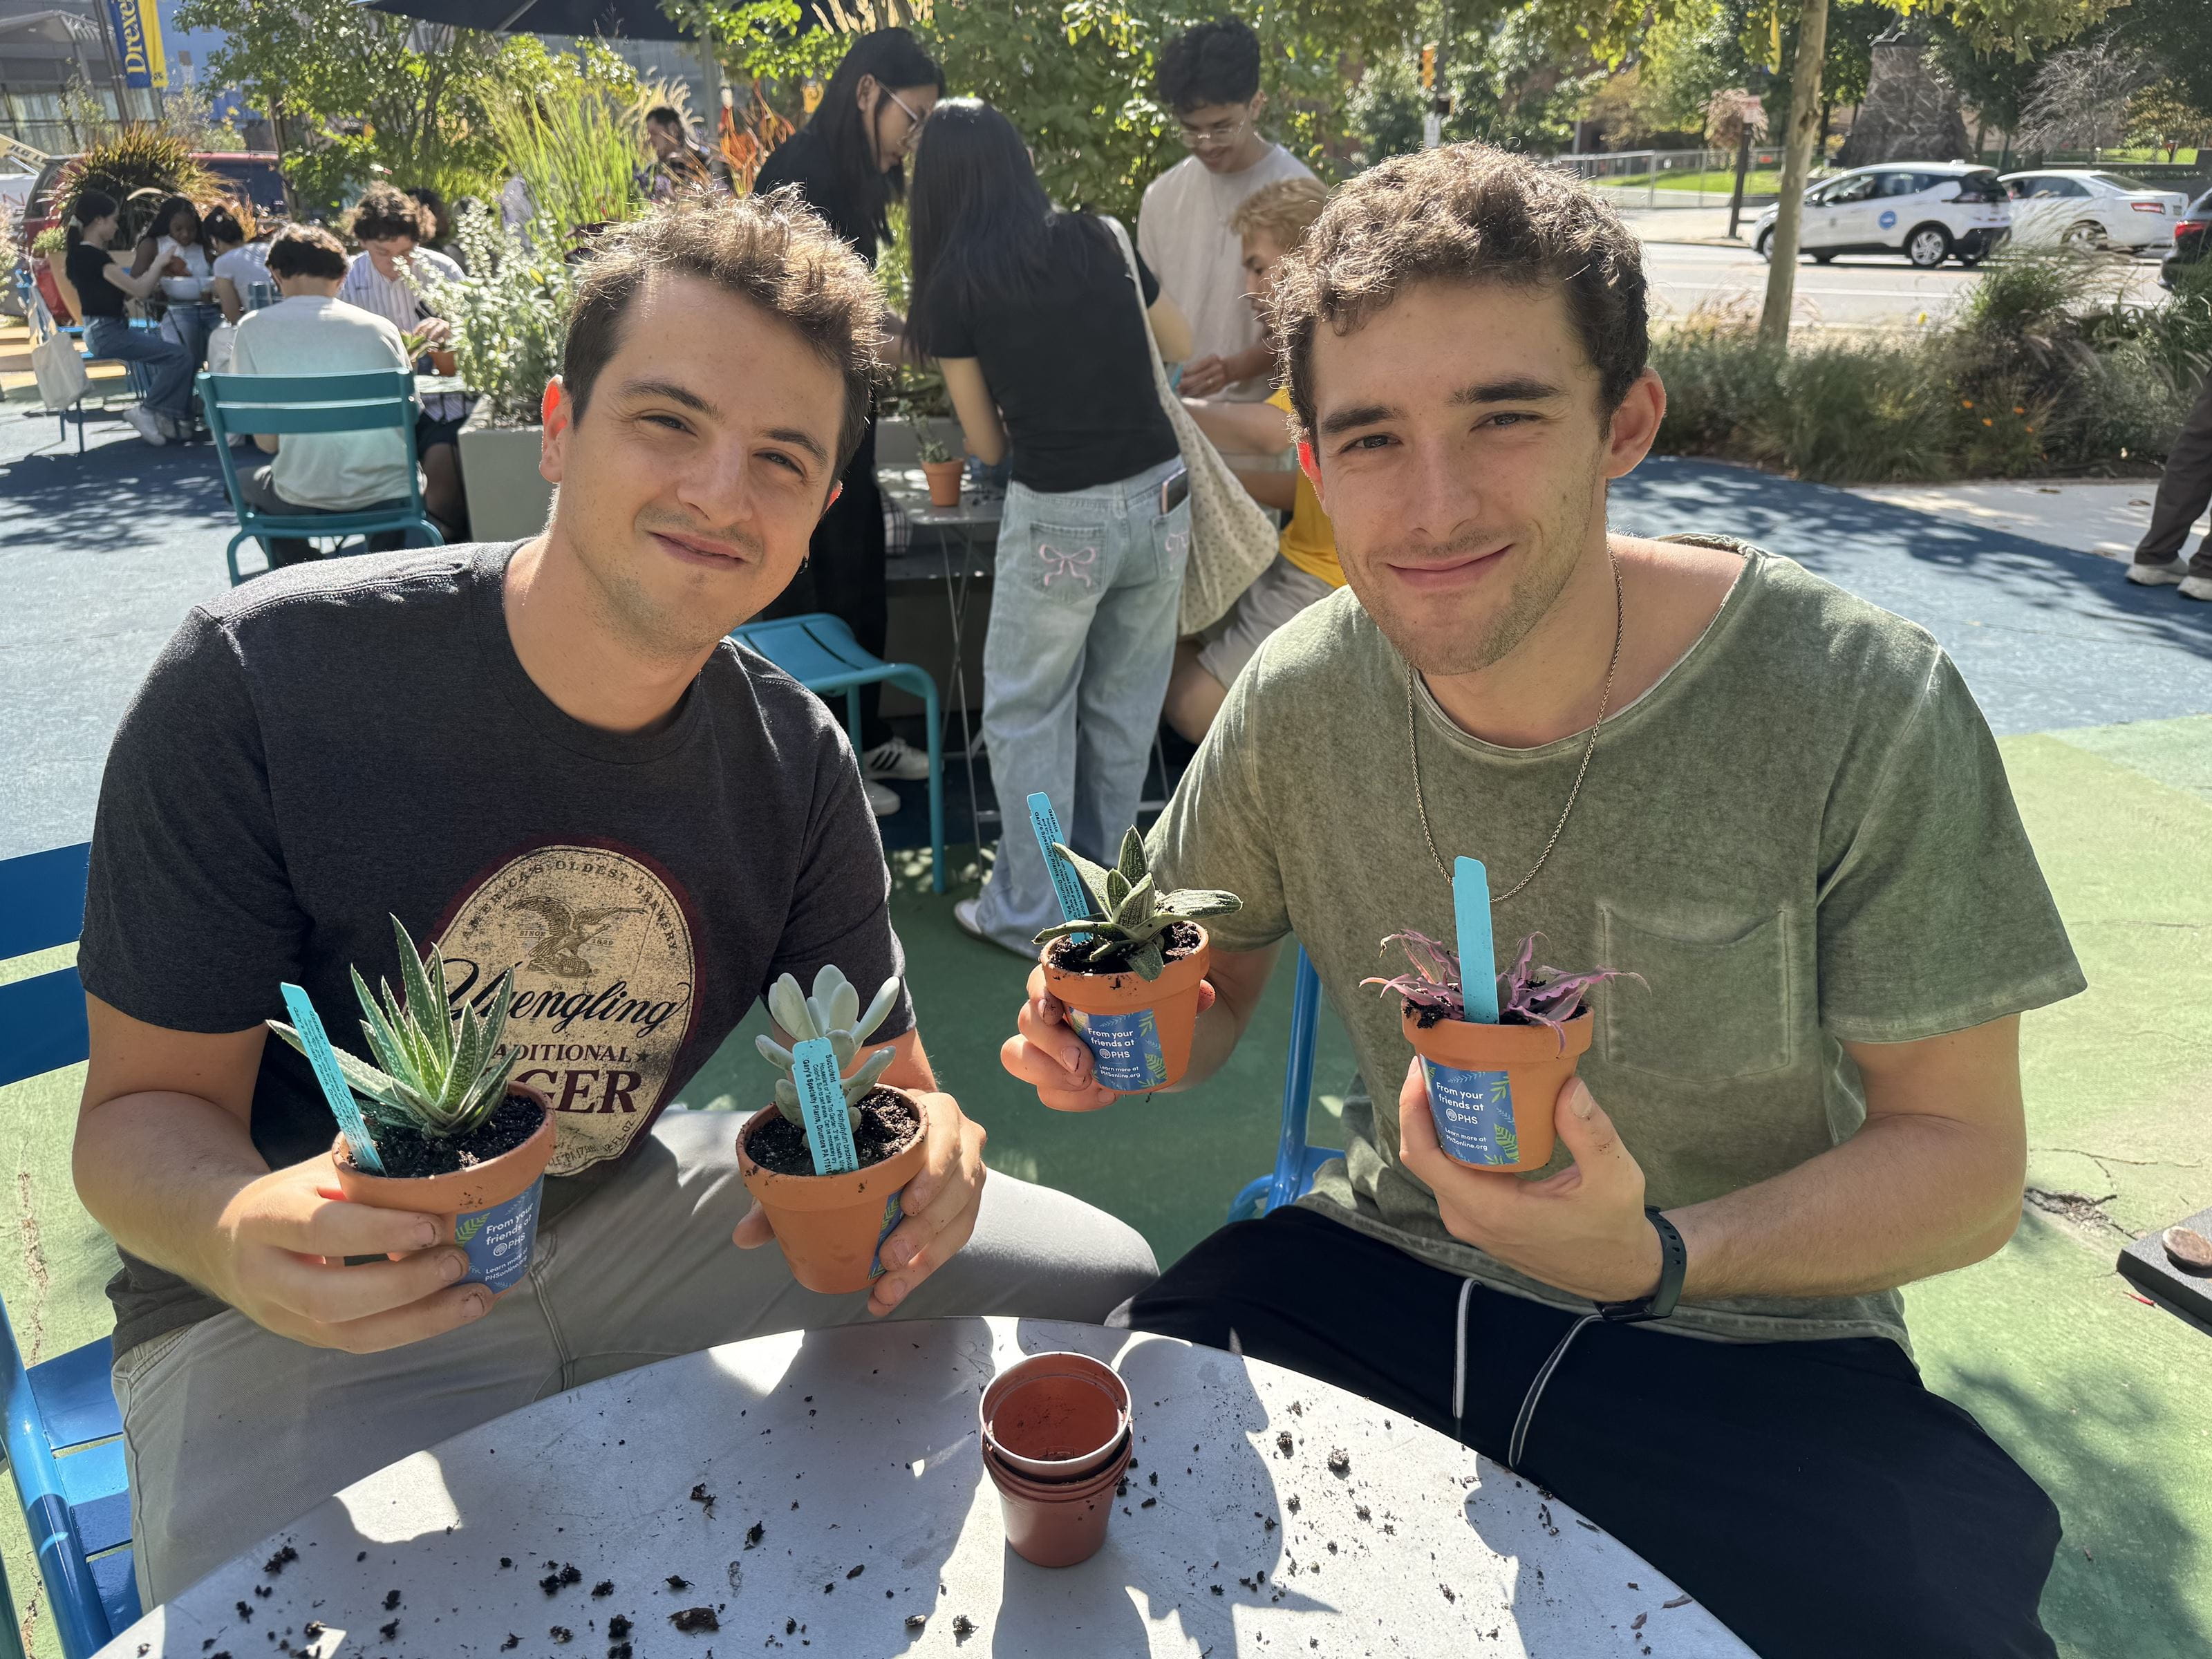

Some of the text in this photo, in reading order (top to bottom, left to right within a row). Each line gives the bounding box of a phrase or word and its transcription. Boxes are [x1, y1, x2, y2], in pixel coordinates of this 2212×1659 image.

[118, 0, 147, 75] Drexe
[555, 859, 629, 882] OLDEST
[1042, 831, 1051, 858] Specialty
[1067, 906, 1072, 915] PA
[428, 958, 691, 1037] Yengling
[1087, 1027, 1134, 1040] From your
[1091, 1037, 1123, 1047] friends
[491, 1044, 633, 1062] ADITIONAL
[803, 1059, 812, 1078] Gary's
[1100, 1069, 1141, 1078] PHSonline.org
[514, 1069, 642, 1114] GER
[806, 1078, 817, 1104] Specialty
[826, 1054, 836, 1082] Succulent
[836, 1109, 849, 1143] Pachyphytum
[1436, 1081, 1484, 1100] From your
[1438, 1093, 1484, 1112] friends at
[812, 1105, 821, 1124] Plants,
[1458, 1113, 1478, 1125] PHS
[818, 1125, 826, 1148] Drumore
[1445, 1127, 1460, 1138] Learn
[1446, 1134, 1488, 1151] PHSonline.org
[822, 1149, 828, 1157] PA
[486, 1203, 534, 1234] From your
[486, 1214, 532, 1245] friends at
[508, 1232, 526, 1249] PHS
[485, 1255, 527, 1282] PHSonline.org
[486, 1263, 506, 1274] Learn
[507, 1253, 522, 1265] more
